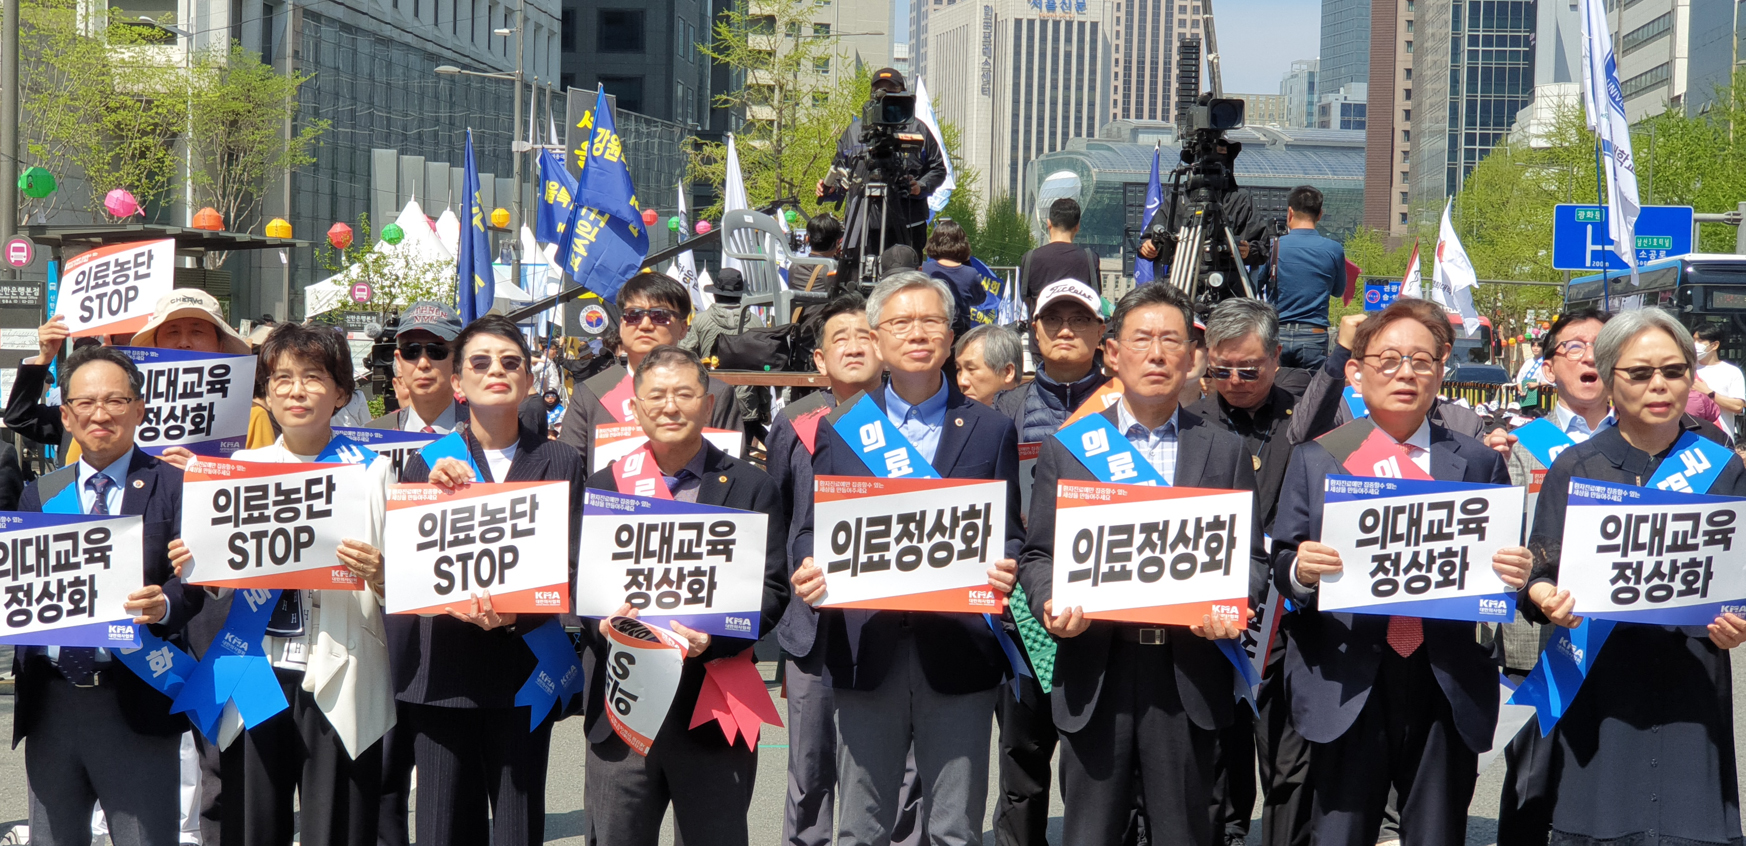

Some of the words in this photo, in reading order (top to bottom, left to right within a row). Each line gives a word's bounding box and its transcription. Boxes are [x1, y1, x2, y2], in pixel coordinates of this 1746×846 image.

[1578, 211, 1602, 220] 광화문
[1637, 239, 1670, 247] 남산3호터널
[1639, 250, 1666, 259] 소공로
[71, 249, 154, 295] 의료농단
[1046, 284, 1093, 302] Titleist
[79, 285, 139, 323] STOP
[139, 364, 231, 404] 의대교육
[138, 402, 215, 442] 정상화
[859, 420, 913, 478] 의료
[1081, 428, 1138, 482] 의료
[211, 474, 336, 528] 의료농단
[417, 493, 539, 552] 의료농단
[1355, 497, 1489, 550] 의대교육
[0, 527, 113, 582] 의대교육
[227, 525, 315, 570] STOP
[612, 520, 736, 564] 의대교육
[827, 502, 992, 577] 의료정상화
[1067, 513, 1237, 587] 의료정상화
[1596, 509, 1736, 558] 의대교육
[433, 545, 519, 596] STOP
[624, 566, 717, 610] 정상화
[1369, 545, 1469, 598] 정상화
[1609, 556, 1713, 606] 정상화
[4, 574, 98, 628] 정상화
[969, 591, 995, 599] KMA
[1479, 599, 1506, 608] KMA
[108, 625, 134, 633] KMA
[725, 616, 751, 625] KMA
[145, 646, 174, 678] 화
